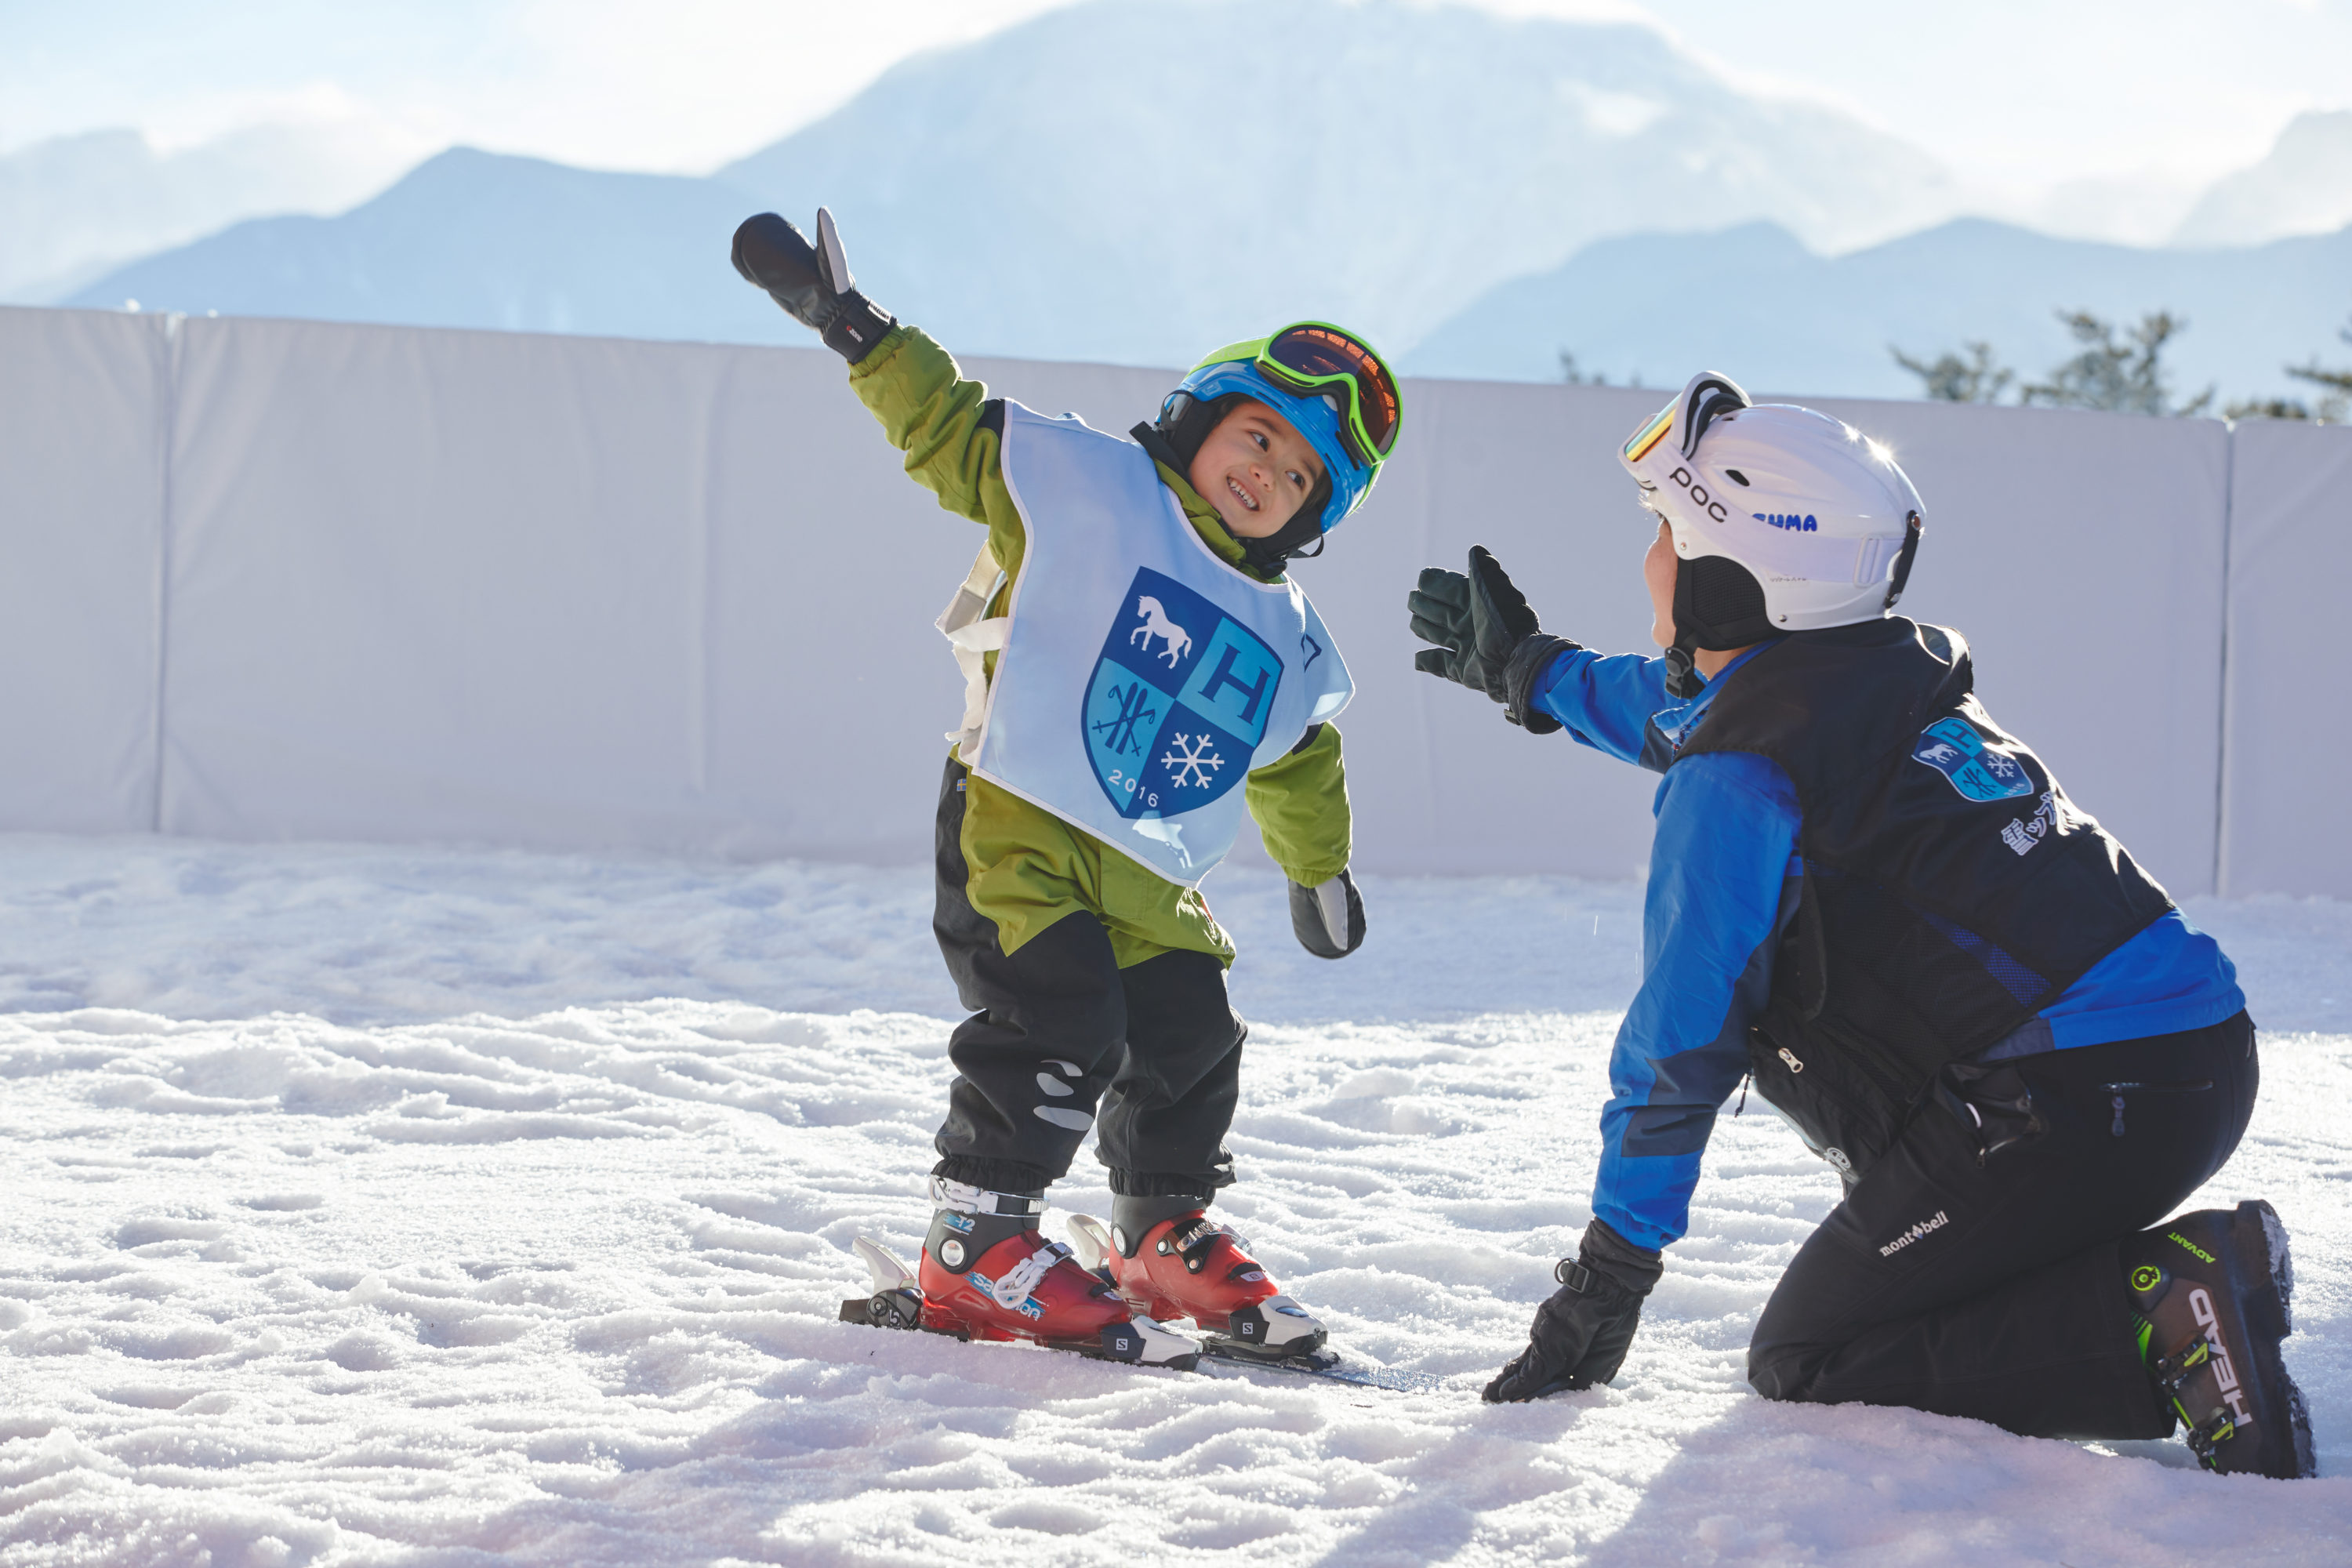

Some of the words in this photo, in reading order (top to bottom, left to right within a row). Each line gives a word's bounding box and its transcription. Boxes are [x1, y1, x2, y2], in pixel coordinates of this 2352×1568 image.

[1197, 643, 1272, 726] H
[1941, 722, 1980, 749] H
[1108, 769, 1159, 808] 2016
[1117, 1339, 1127, 1349] S
[1243, 1323, 1252, 1334] S
[2189, 1289, 2252, 1427] HEAD
